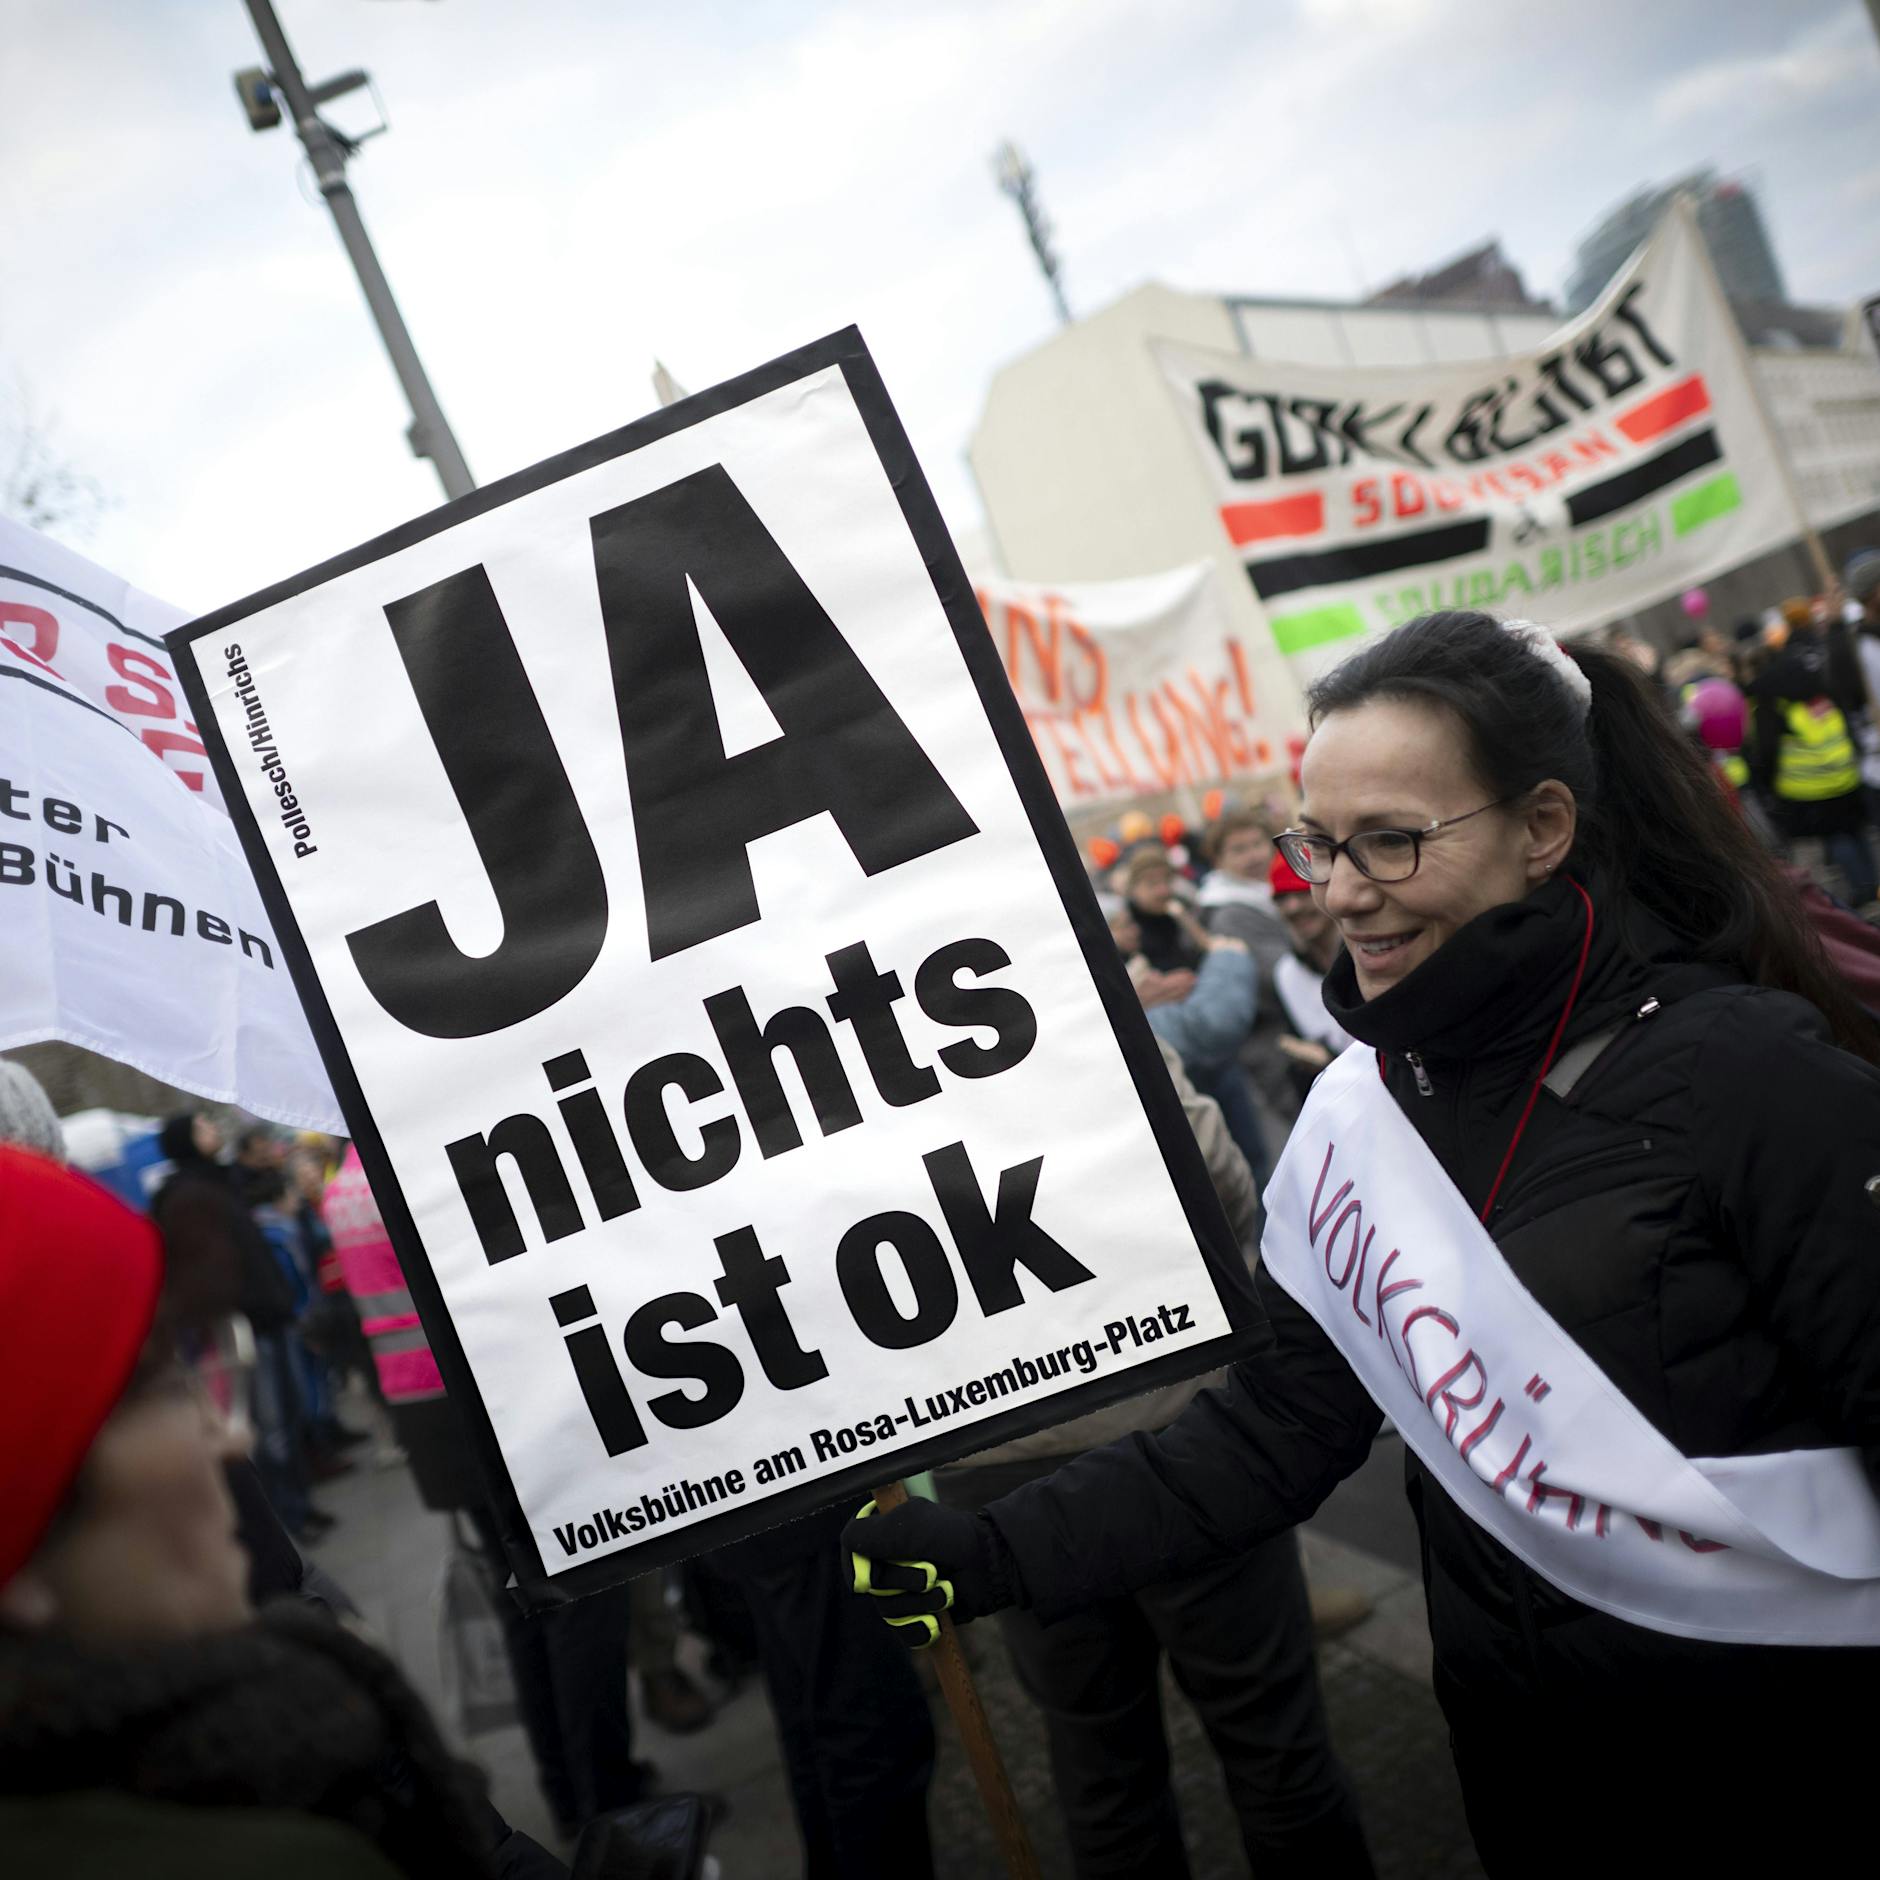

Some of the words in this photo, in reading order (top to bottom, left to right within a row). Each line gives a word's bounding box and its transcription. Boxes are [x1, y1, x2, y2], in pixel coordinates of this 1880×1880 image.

[223, 643, 318, 859] Pollesch/Hinrichs
[344, 462, 981, 1040] JA
[0, 841, 274, 970] Bühnen
[444, 937, 1038, 1266] nichts
[548, 1224, 830, 1458] ist
[835, 1140, 1097, 1350] ok
[552, 1469, 746, 1557] Volksbühne
[753, 1446, 807, 1485] am
[809, 1303, 1196, 1463] Rosa-Luxemburg-Platz
